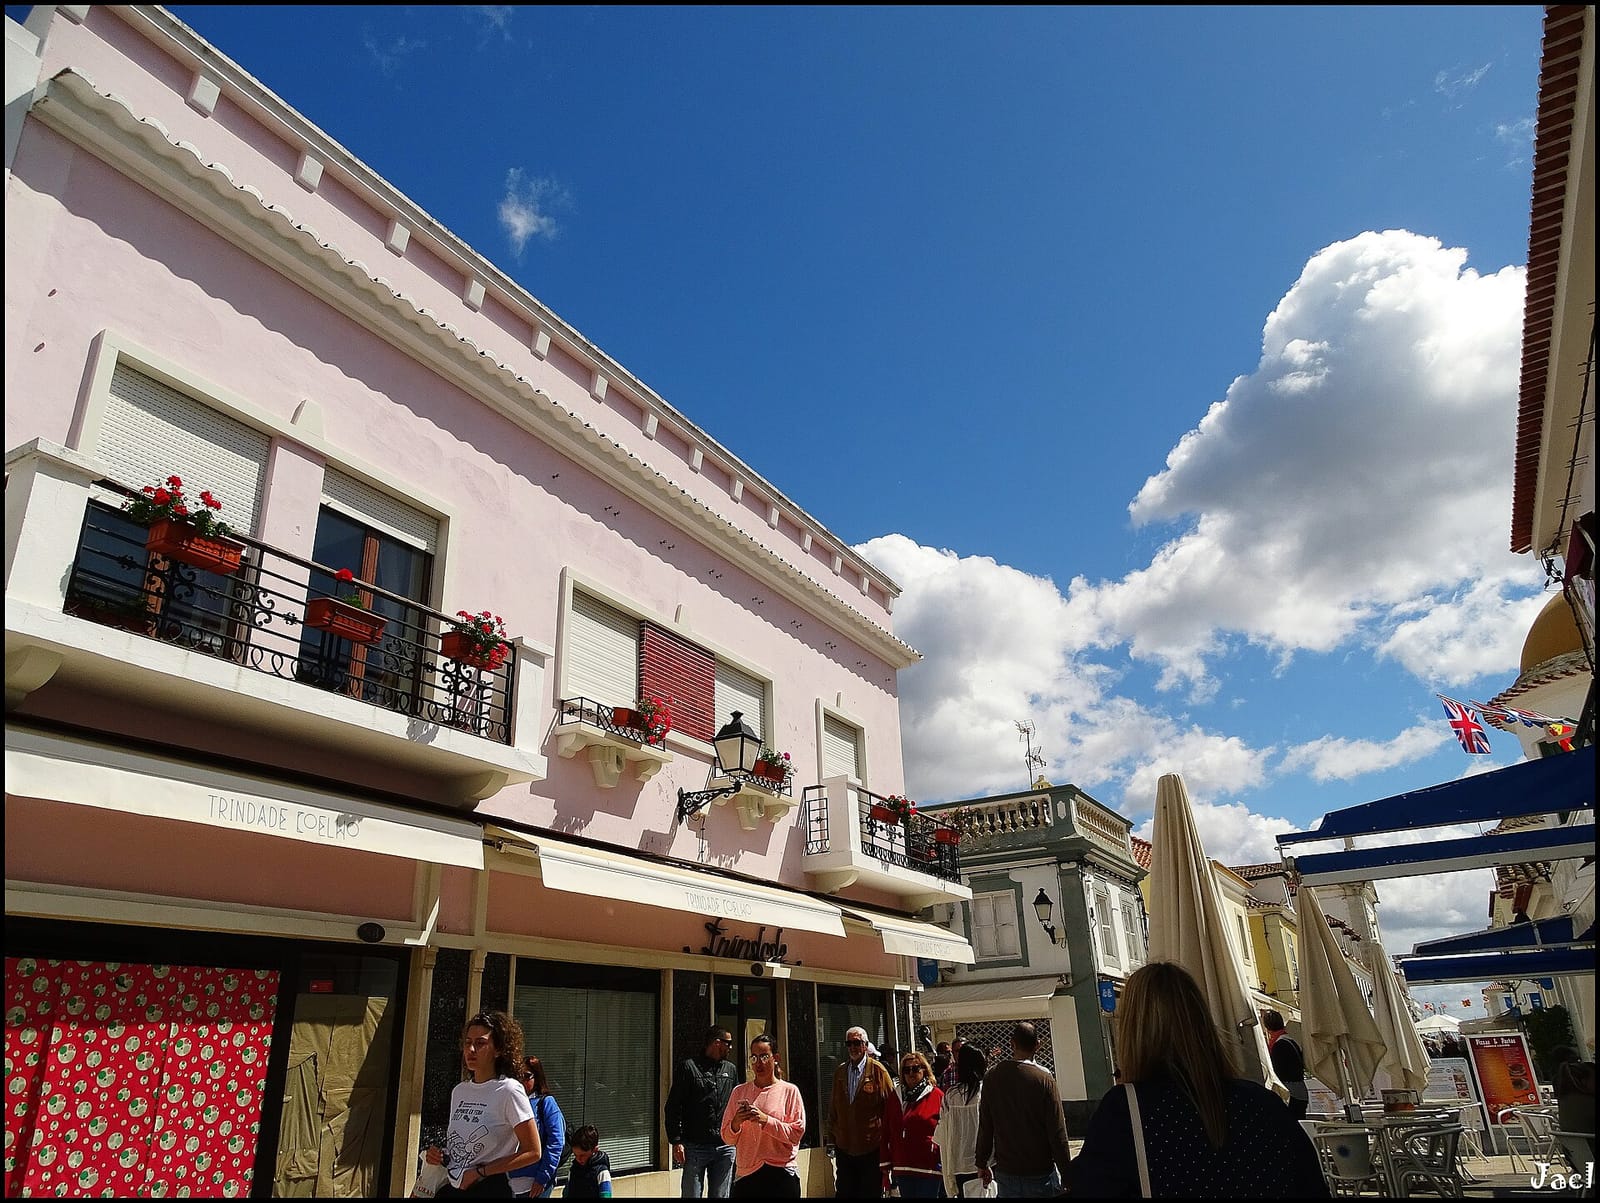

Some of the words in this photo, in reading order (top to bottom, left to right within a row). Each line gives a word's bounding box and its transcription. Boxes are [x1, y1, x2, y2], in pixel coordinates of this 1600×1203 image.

[207, 794, 289, 831] TRINDADE
[296, 811, 360, 840] COELHO
[685, 891, 722, 914] TRINDADE
[722, 898, 753, 917] COELHO
